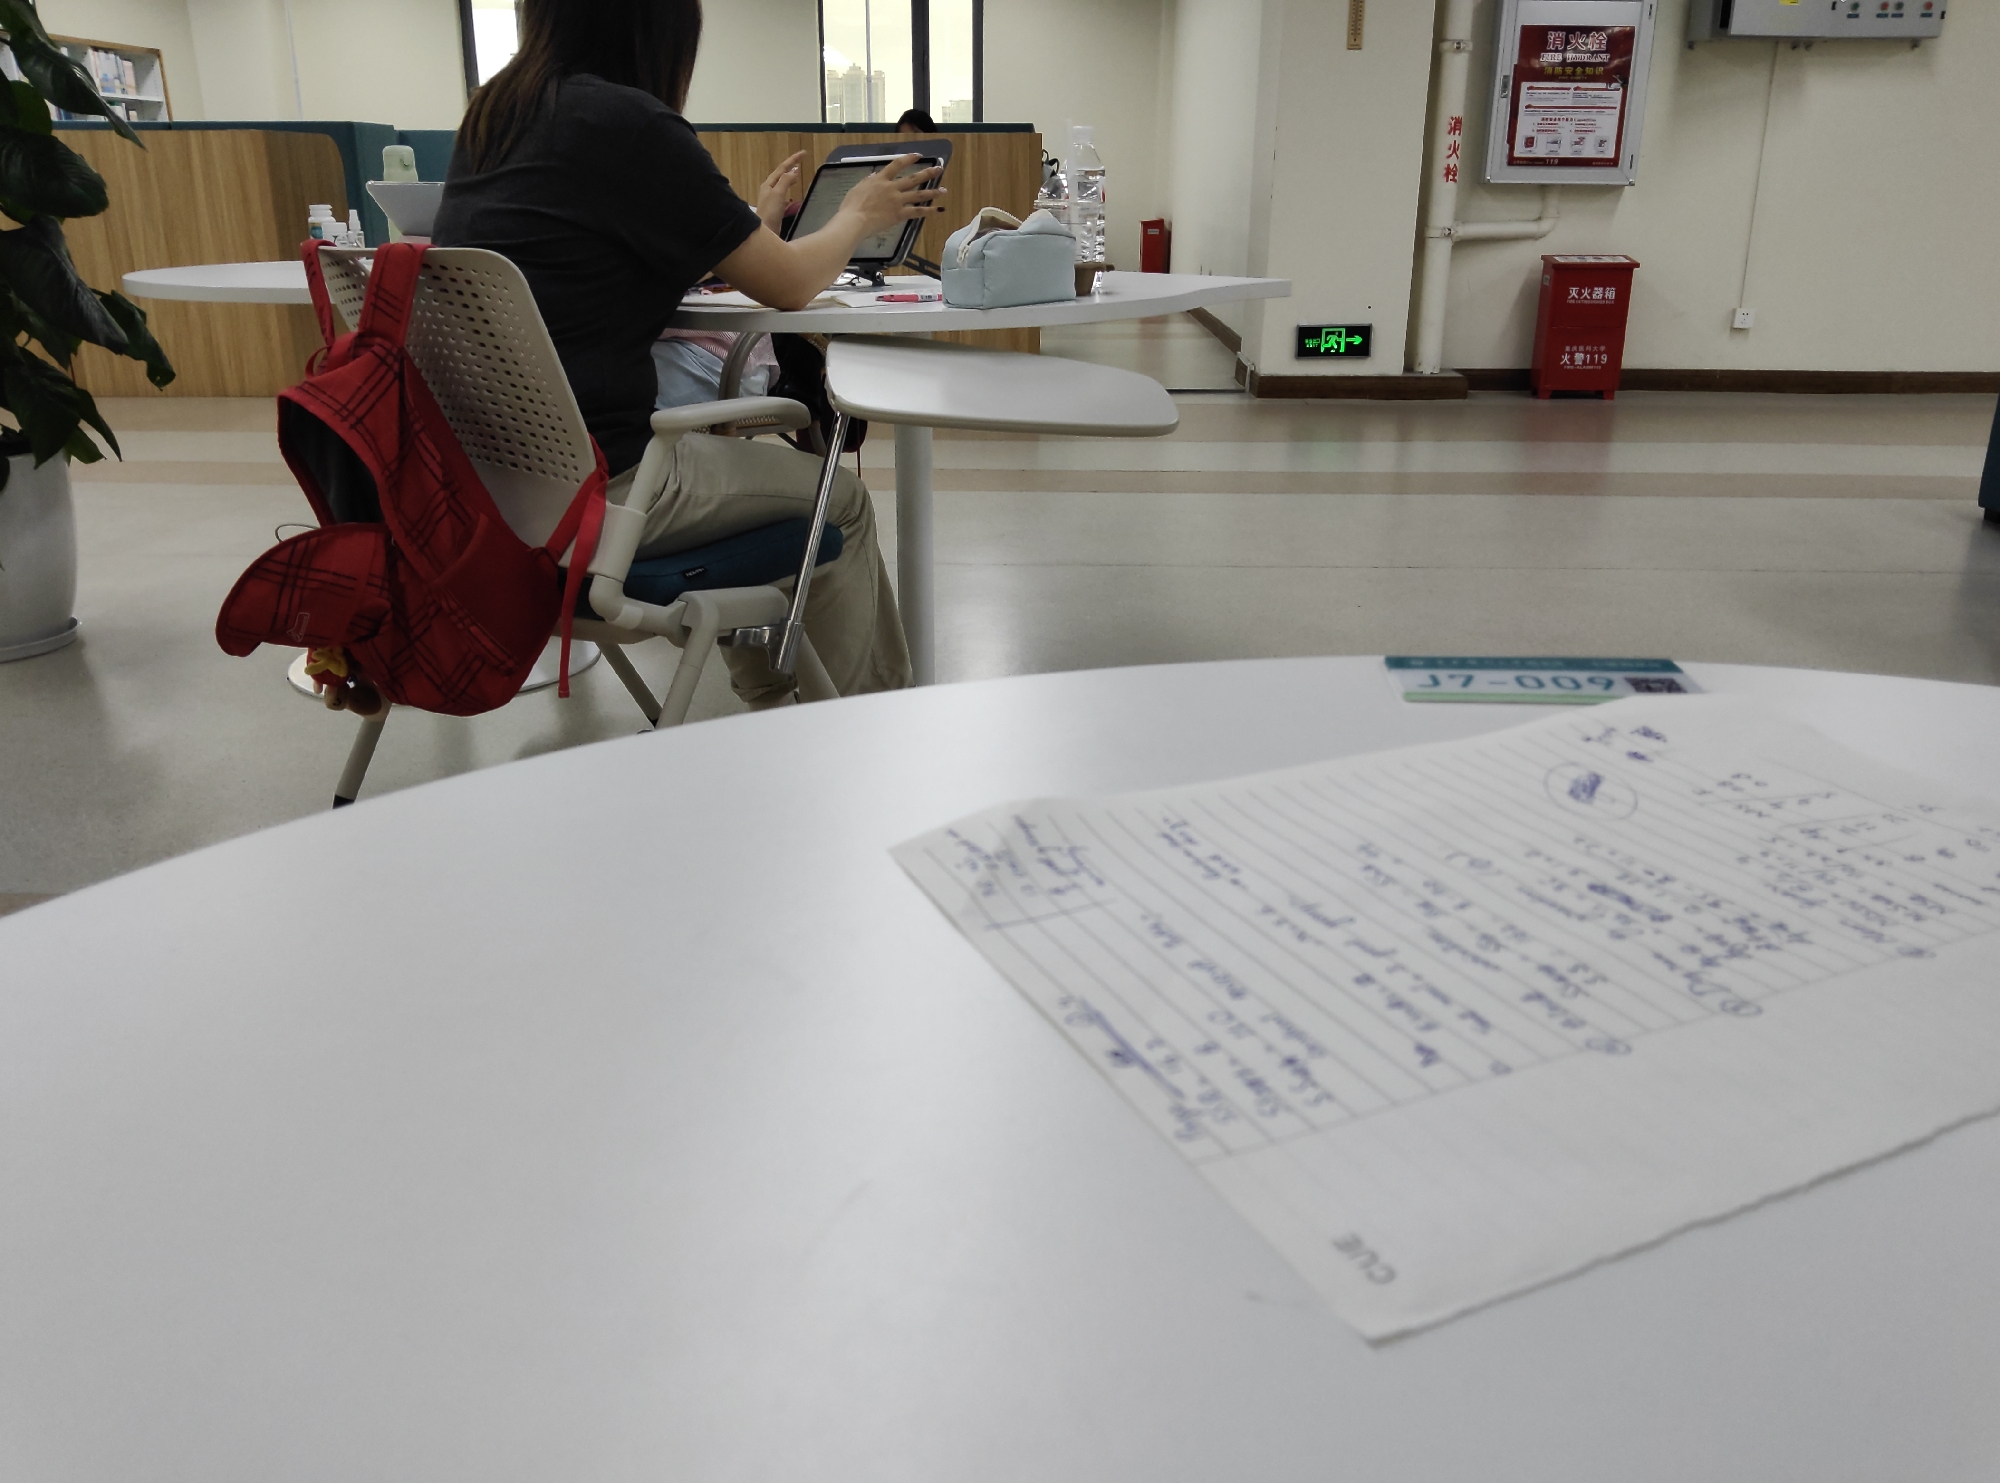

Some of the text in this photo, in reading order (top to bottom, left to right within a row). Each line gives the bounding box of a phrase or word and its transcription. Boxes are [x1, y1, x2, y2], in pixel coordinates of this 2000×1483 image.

[1546, 31, 1608, 51] 消火栓
[1540, 52, 1563, 62] FIRE
[1544, 66, 1604, 75] 消防安全知识
[1443, 116, 1463, 184] 消火栓
[1568, 287, 1616, 299] 灭火器箱
[1417, 673, 1616, 692] J7-009
[1332, 1232, 1397, 1285] CUE
